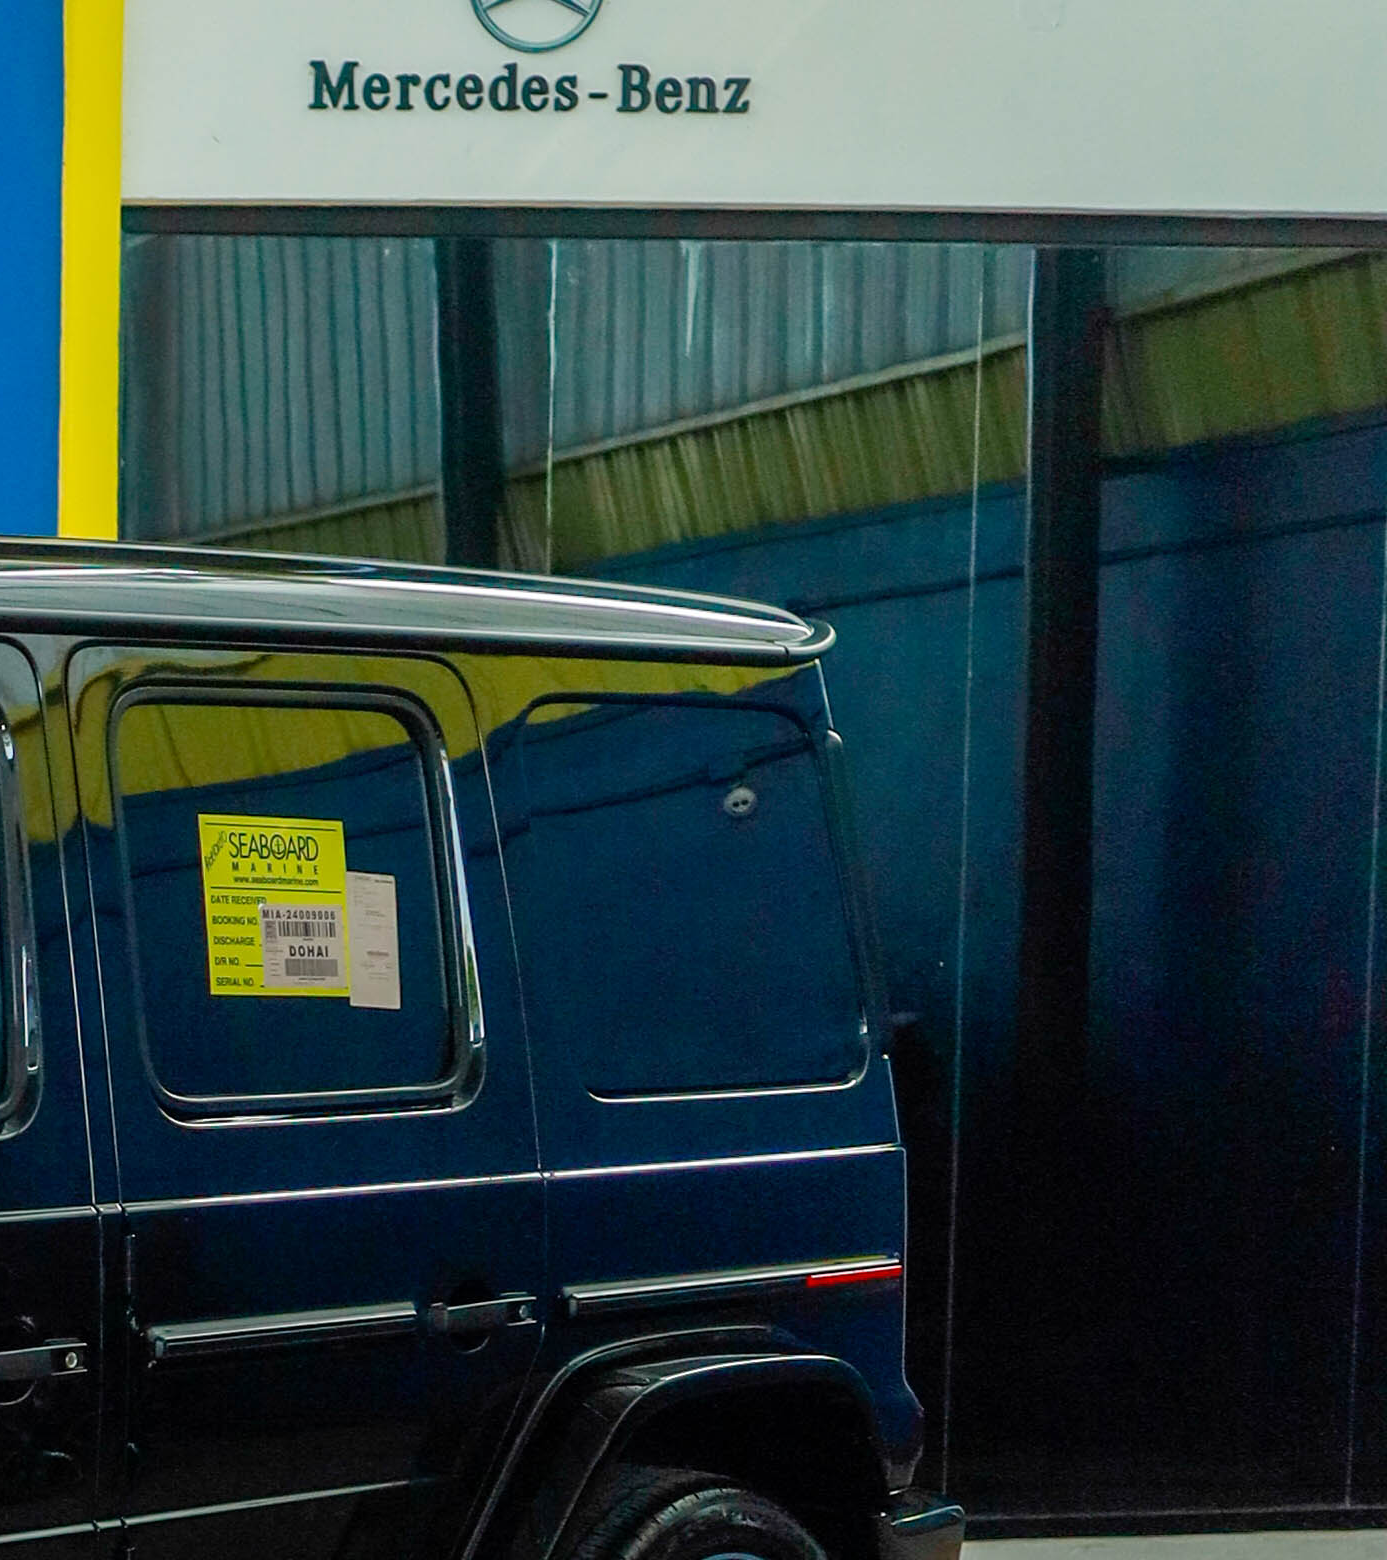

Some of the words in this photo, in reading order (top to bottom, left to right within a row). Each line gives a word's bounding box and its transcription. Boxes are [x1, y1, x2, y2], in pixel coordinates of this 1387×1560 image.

[308, 60, 752, 114] Mercedes-Benz
[228, 832, 319, 861] SEABOARD
[231, 861, 319, 876] MARINE
[210, 895, 230, 905] DATE
[212, 915, 245, 926] BOOKING
[213, 936, 255, 946] DISCHARGE
[289, 945, 329, 958] DOHAI
[215, 976, 242, 987] SERIAL
